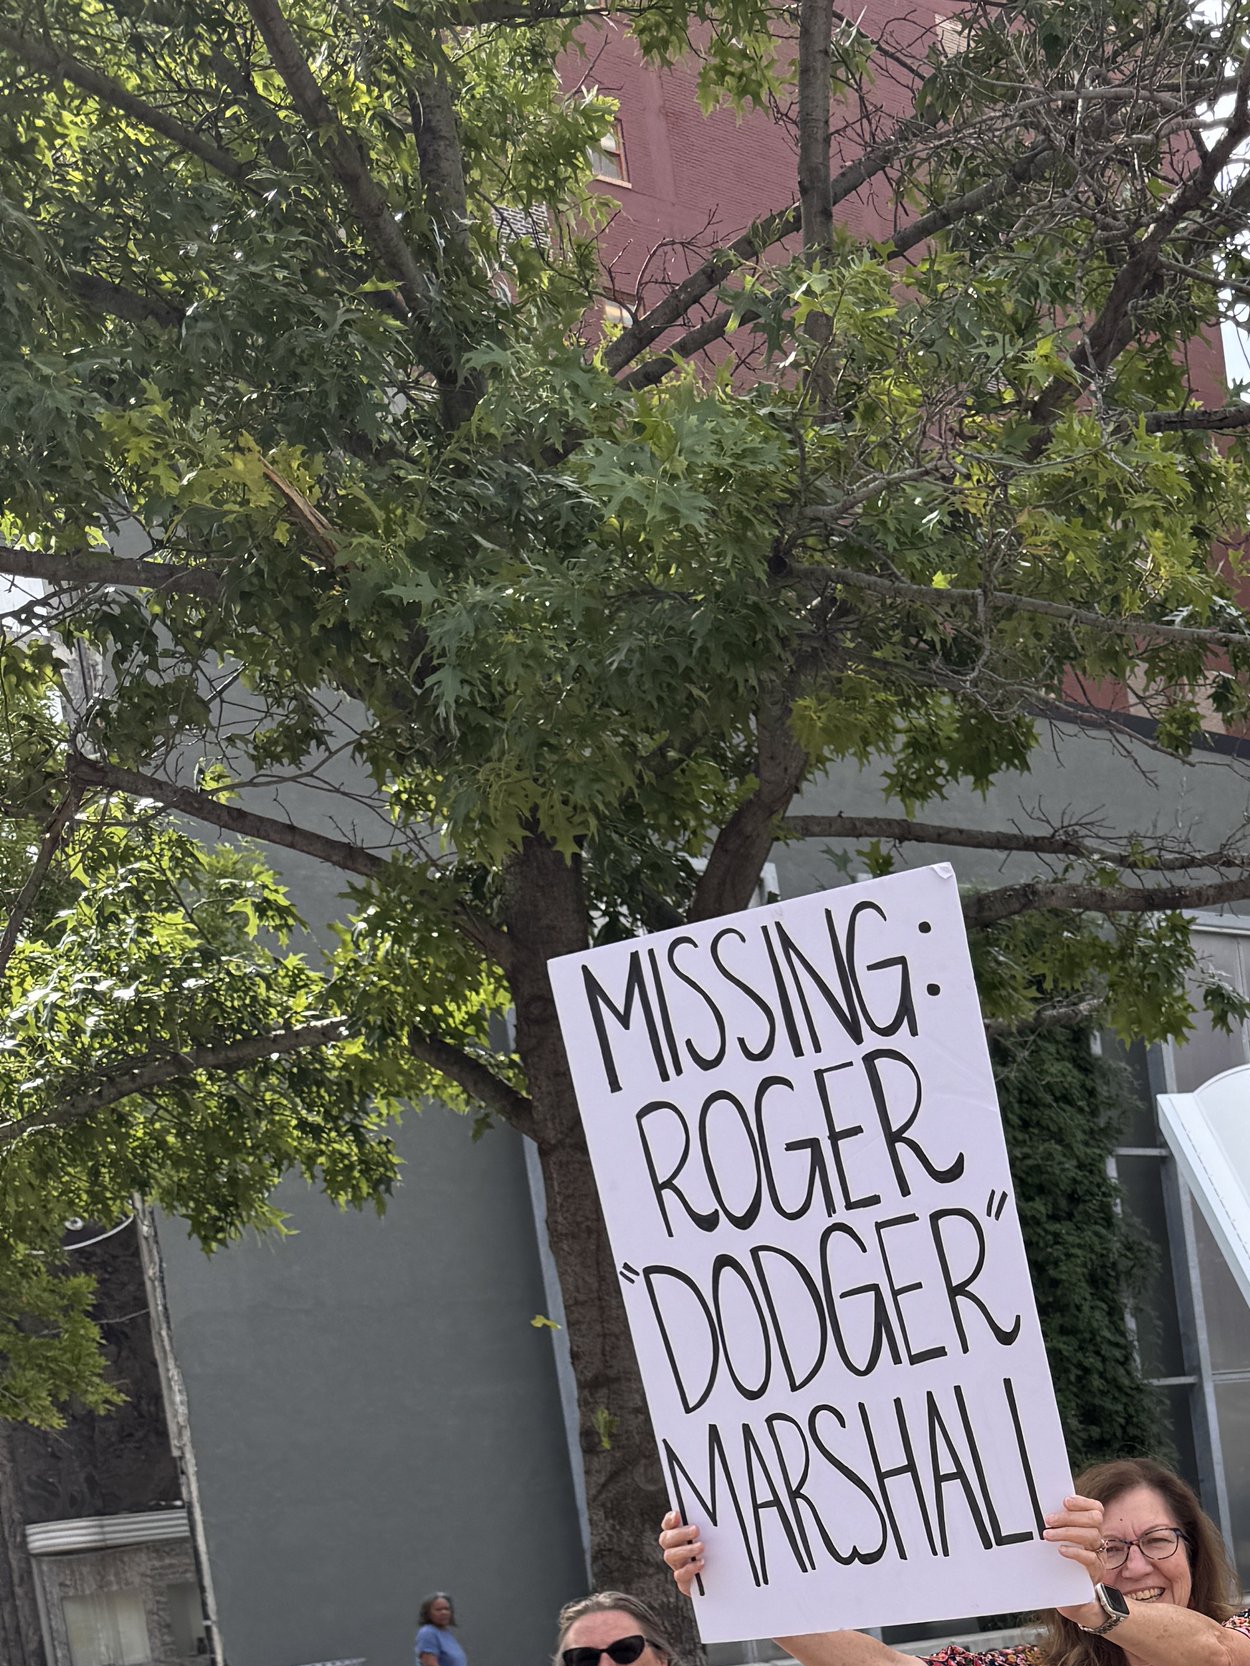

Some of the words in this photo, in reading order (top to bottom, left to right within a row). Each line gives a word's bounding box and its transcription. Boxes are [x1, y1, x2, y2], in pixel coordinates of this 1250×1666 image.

[580, 899, 942, 1093] MISSING:
[635, 1048, 965, 1238] ROGER
[617, 1189, 1022, 1415] "DODGER"
[662, 1376, 1056, 1597] MARSHALL
